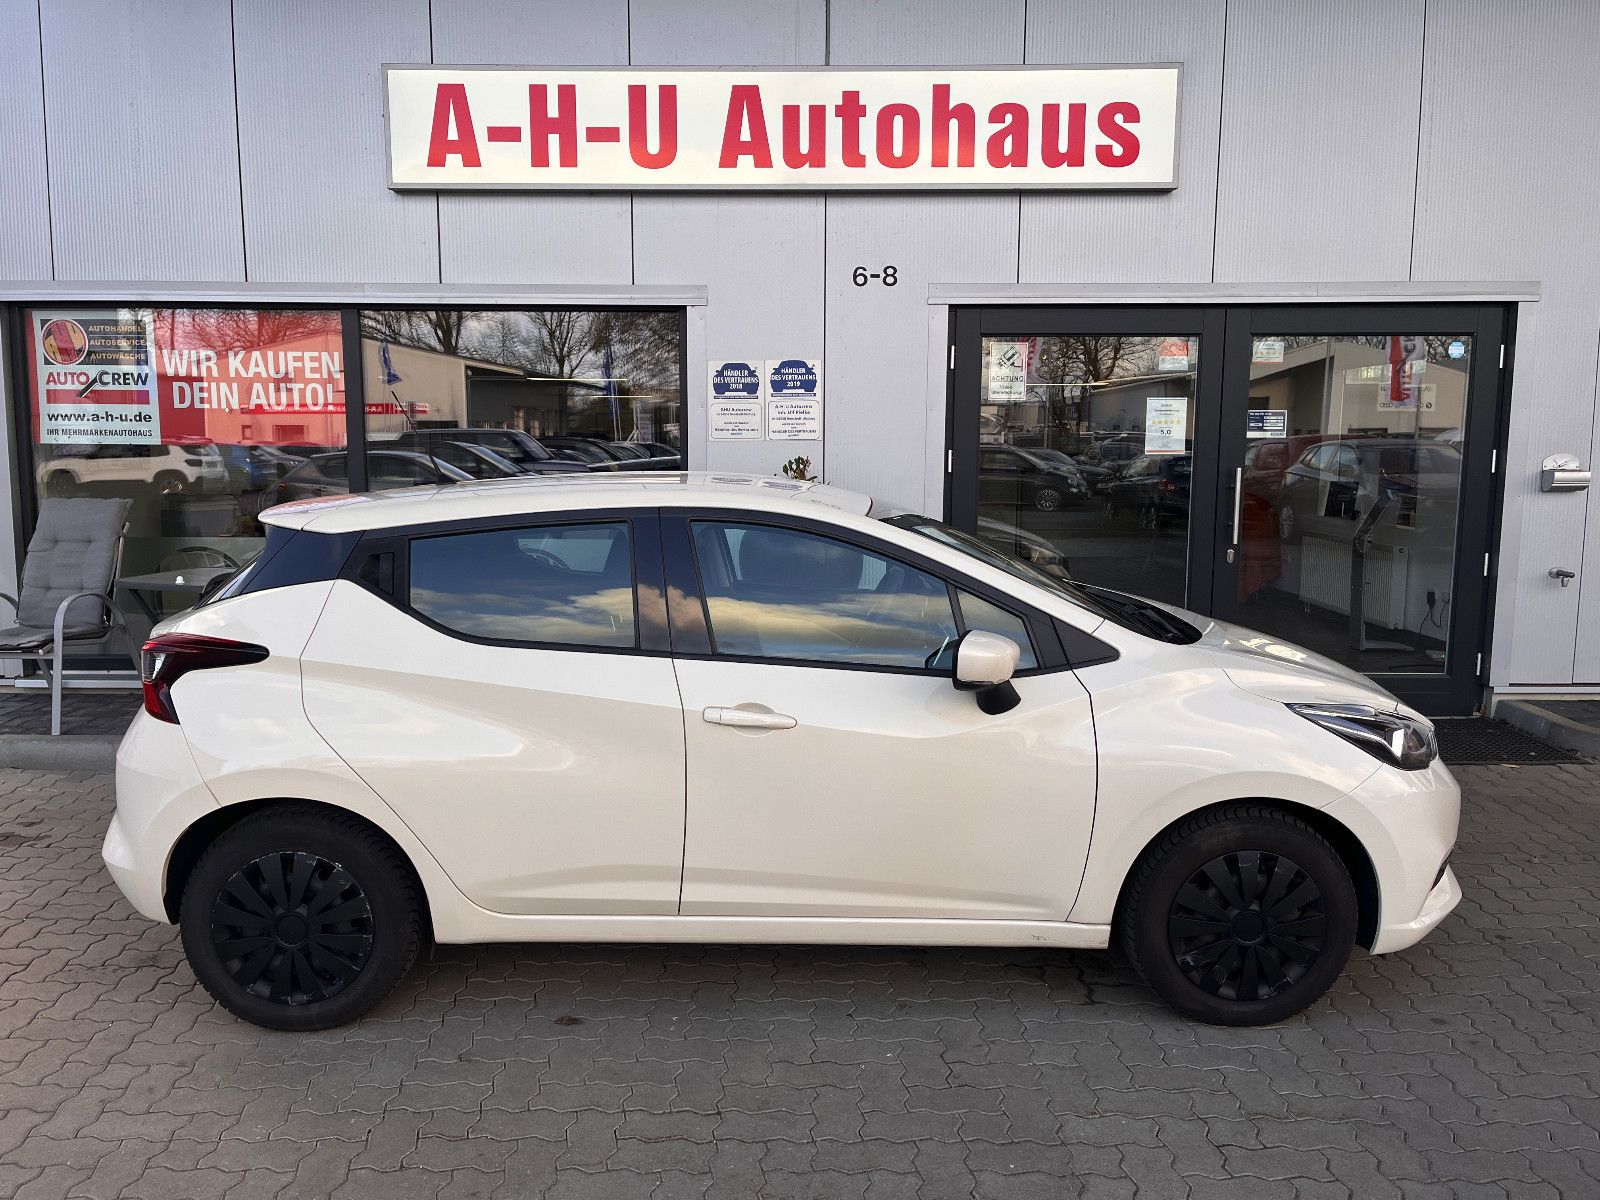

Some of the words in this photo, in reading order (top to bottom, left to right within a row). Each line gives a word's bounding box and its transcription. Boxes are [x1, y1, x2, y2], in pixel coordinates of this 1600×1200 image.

[427, 83, 677, 169] A-H-U
[718, 84, 1140, 169] Autohaus
[853, 265, 898, 287] 6-8
[88, 325, 144, 333] AUTOHANDEL
[161, 350, 219, 377] WIR
[227, 350, 341, 379] KAUFEN
[46, 371, 91, 386] AUTO
[97, 369, 149, 387] CREW
[172, 382, 240, 409] DEIN
[248, 382, 334, 411] AUTO!
[46, 411, 153, 423] www.a-h-u.de
[46, 428, 60, 436] IHR
[61, 428, 153, 437] MEHRMARKENAUTOHAUS
